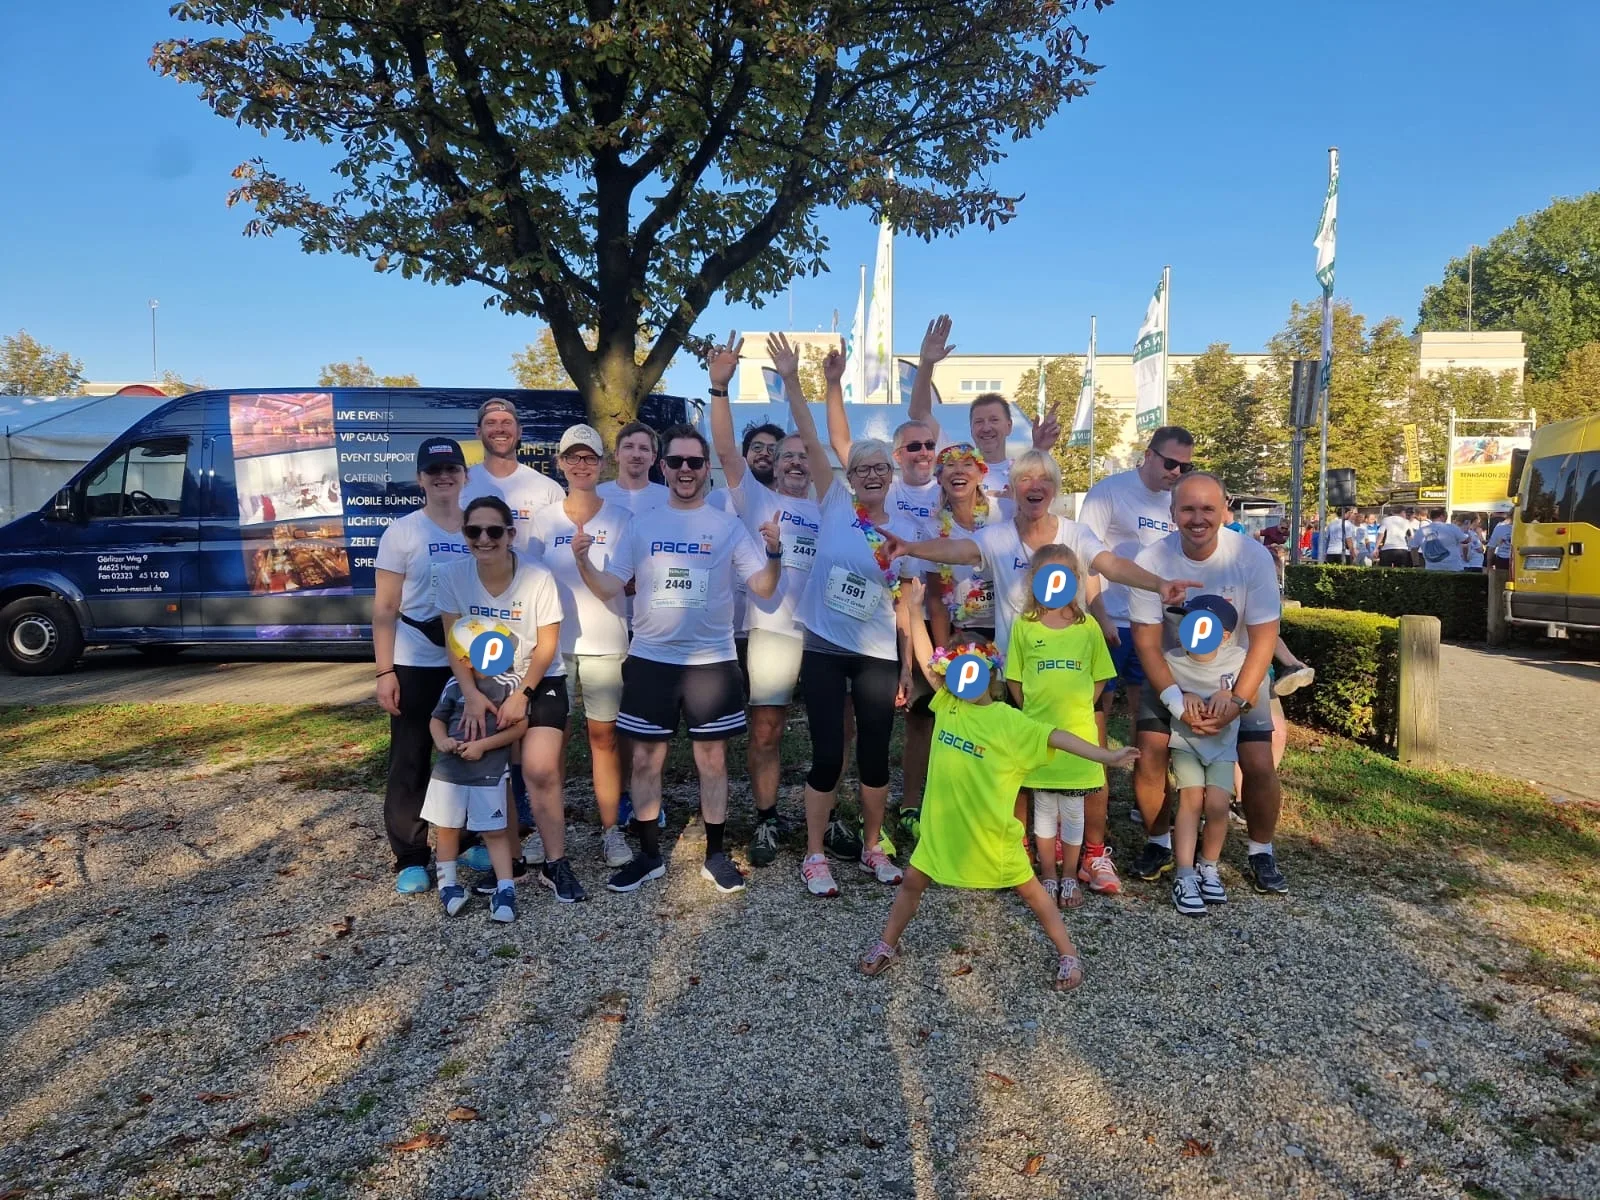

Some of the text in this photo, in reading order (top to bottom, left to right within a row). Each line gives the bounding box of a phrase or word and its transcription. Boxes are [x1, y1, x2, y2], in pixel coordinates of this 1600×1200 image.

[337, 411, 394, 420] LIVE EVENTS
[340, 432, 390, 442] VIP GALAS
[340, 452, 415, 463] EVENT SUPPORT
[343, 473, 392, 483] CATERING
[346, 494, 426, 506] MOBILE BÜHNEN
[350, 537, 377, 547] ZELTE
[793, 545, 817, 557] 2447
[111, 572, 133, 580] 02323
[665, 579, 692, 590] 2449
[841, 583, 866, 600] 1591
